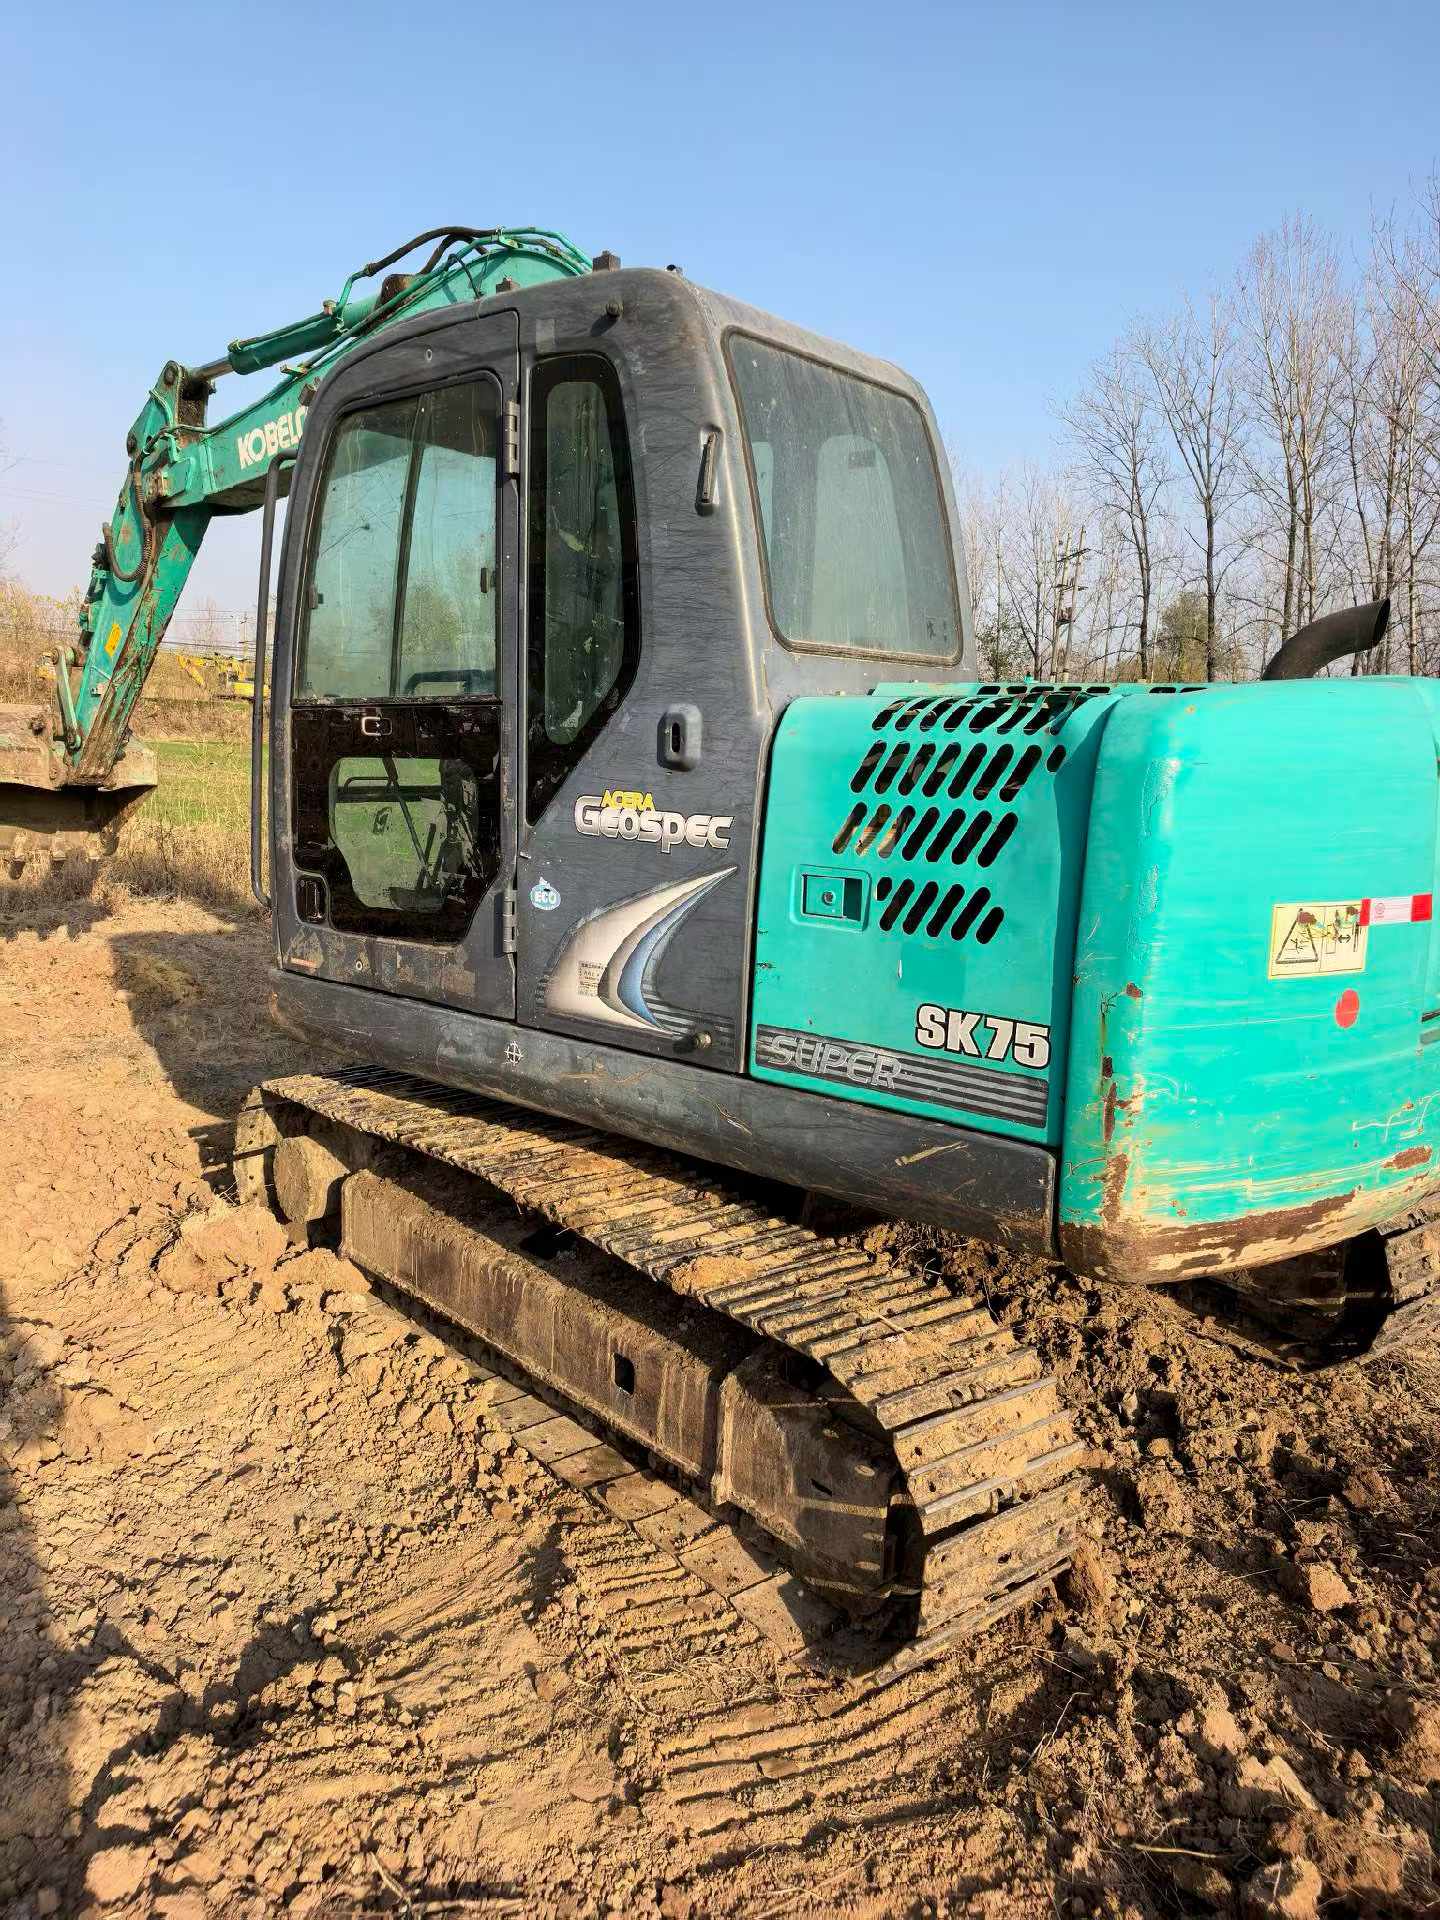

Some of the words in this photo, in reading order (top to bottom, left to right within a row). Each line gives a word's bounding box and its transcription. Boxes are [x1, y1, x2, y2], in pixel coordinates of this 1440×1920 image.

[601, 789, 656, 812] ACERA
[534, 891, 557, 905] ECO
[915, 1003, 1051, 1068] SK75
[767, 1034, 903, 1090] SUPER
